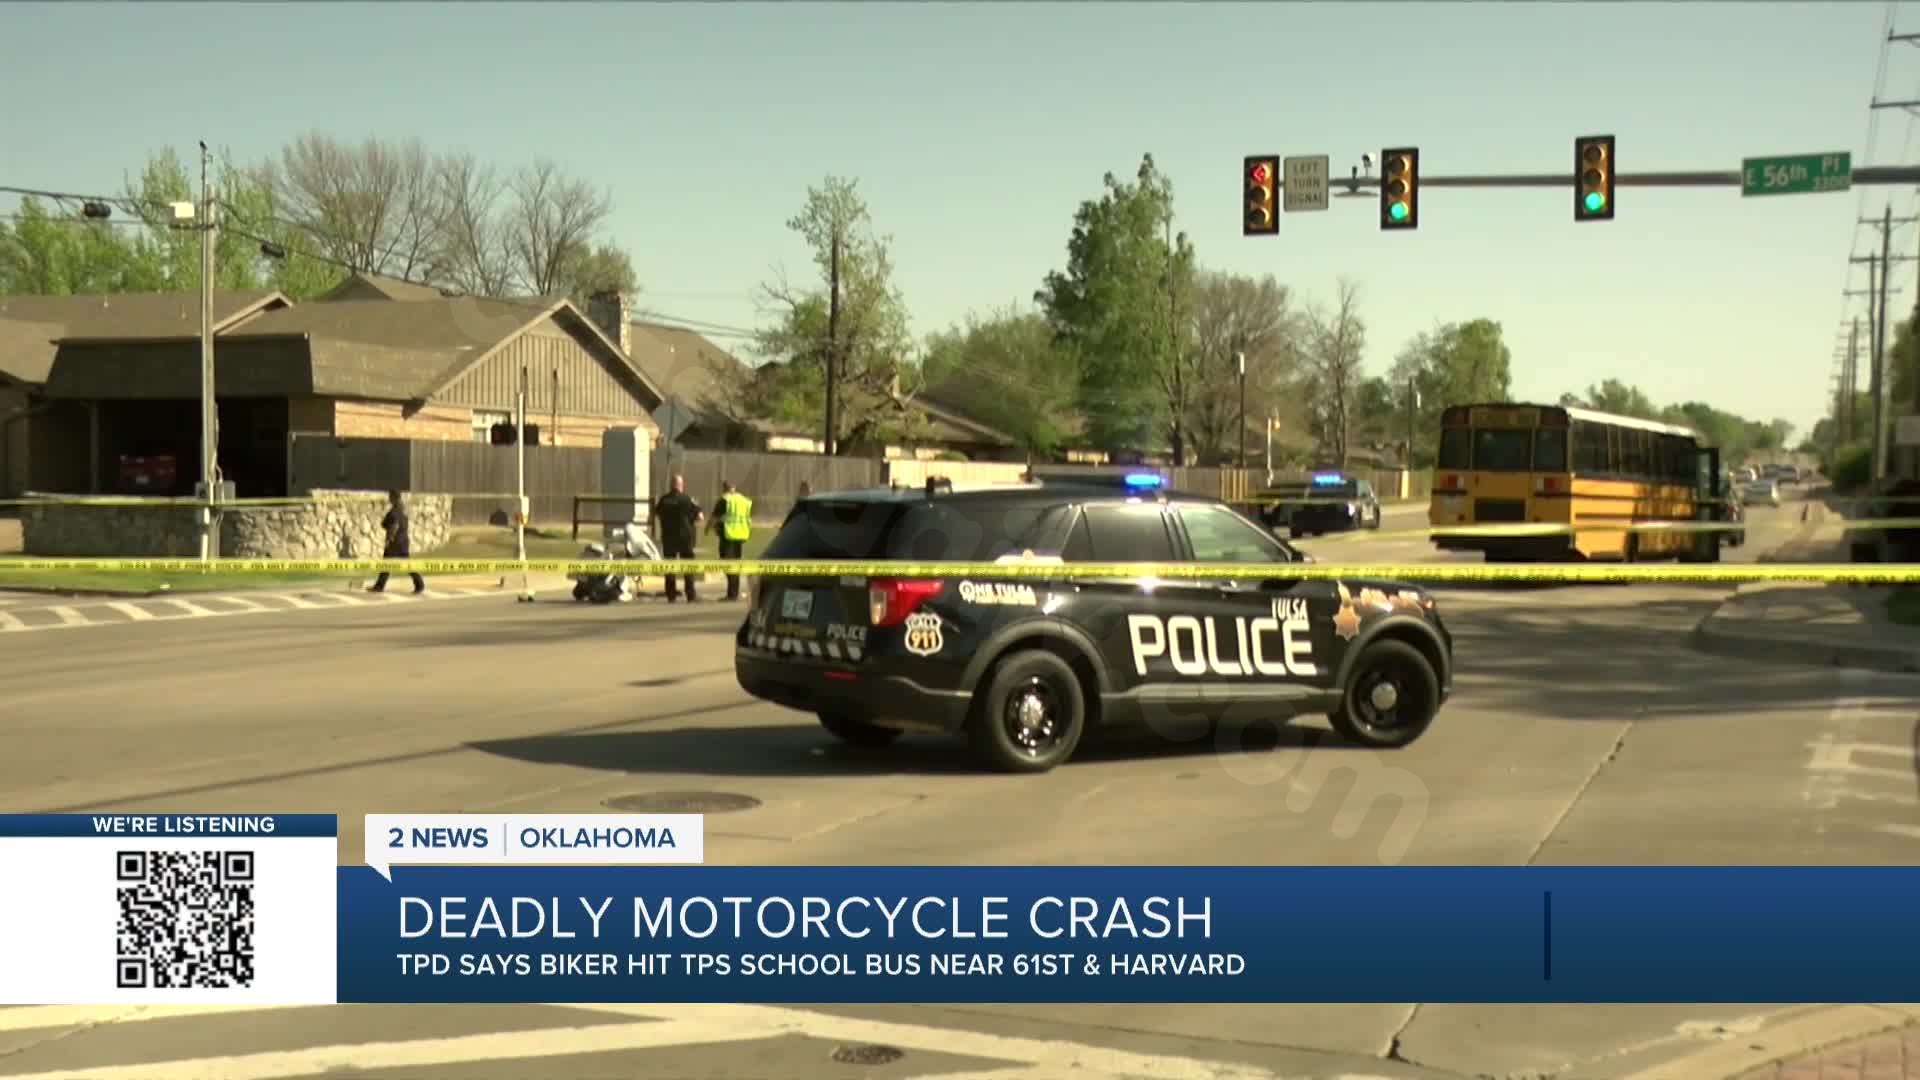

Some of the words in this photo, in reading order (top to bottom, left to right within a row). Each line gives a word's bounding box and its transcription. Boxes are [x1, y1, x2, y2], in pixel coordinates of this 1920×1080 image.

[1293, 162, 1319, 174] LEFT
[1745, 167, 1757, 187] E
[1763, 164, 1808, 187] 56th
[1293, 176, 1321, 189] TURN
[1288, 192, 1323, 204] SIGNAL
[995, 583, 1035, 598] TULSA
[1271, 598, 1308, 620] TULSA
[827, 623, 868, 641] POLICE
[911, 630, 938, 648] 911
[1128, 615, 1317, 675] POLICE
